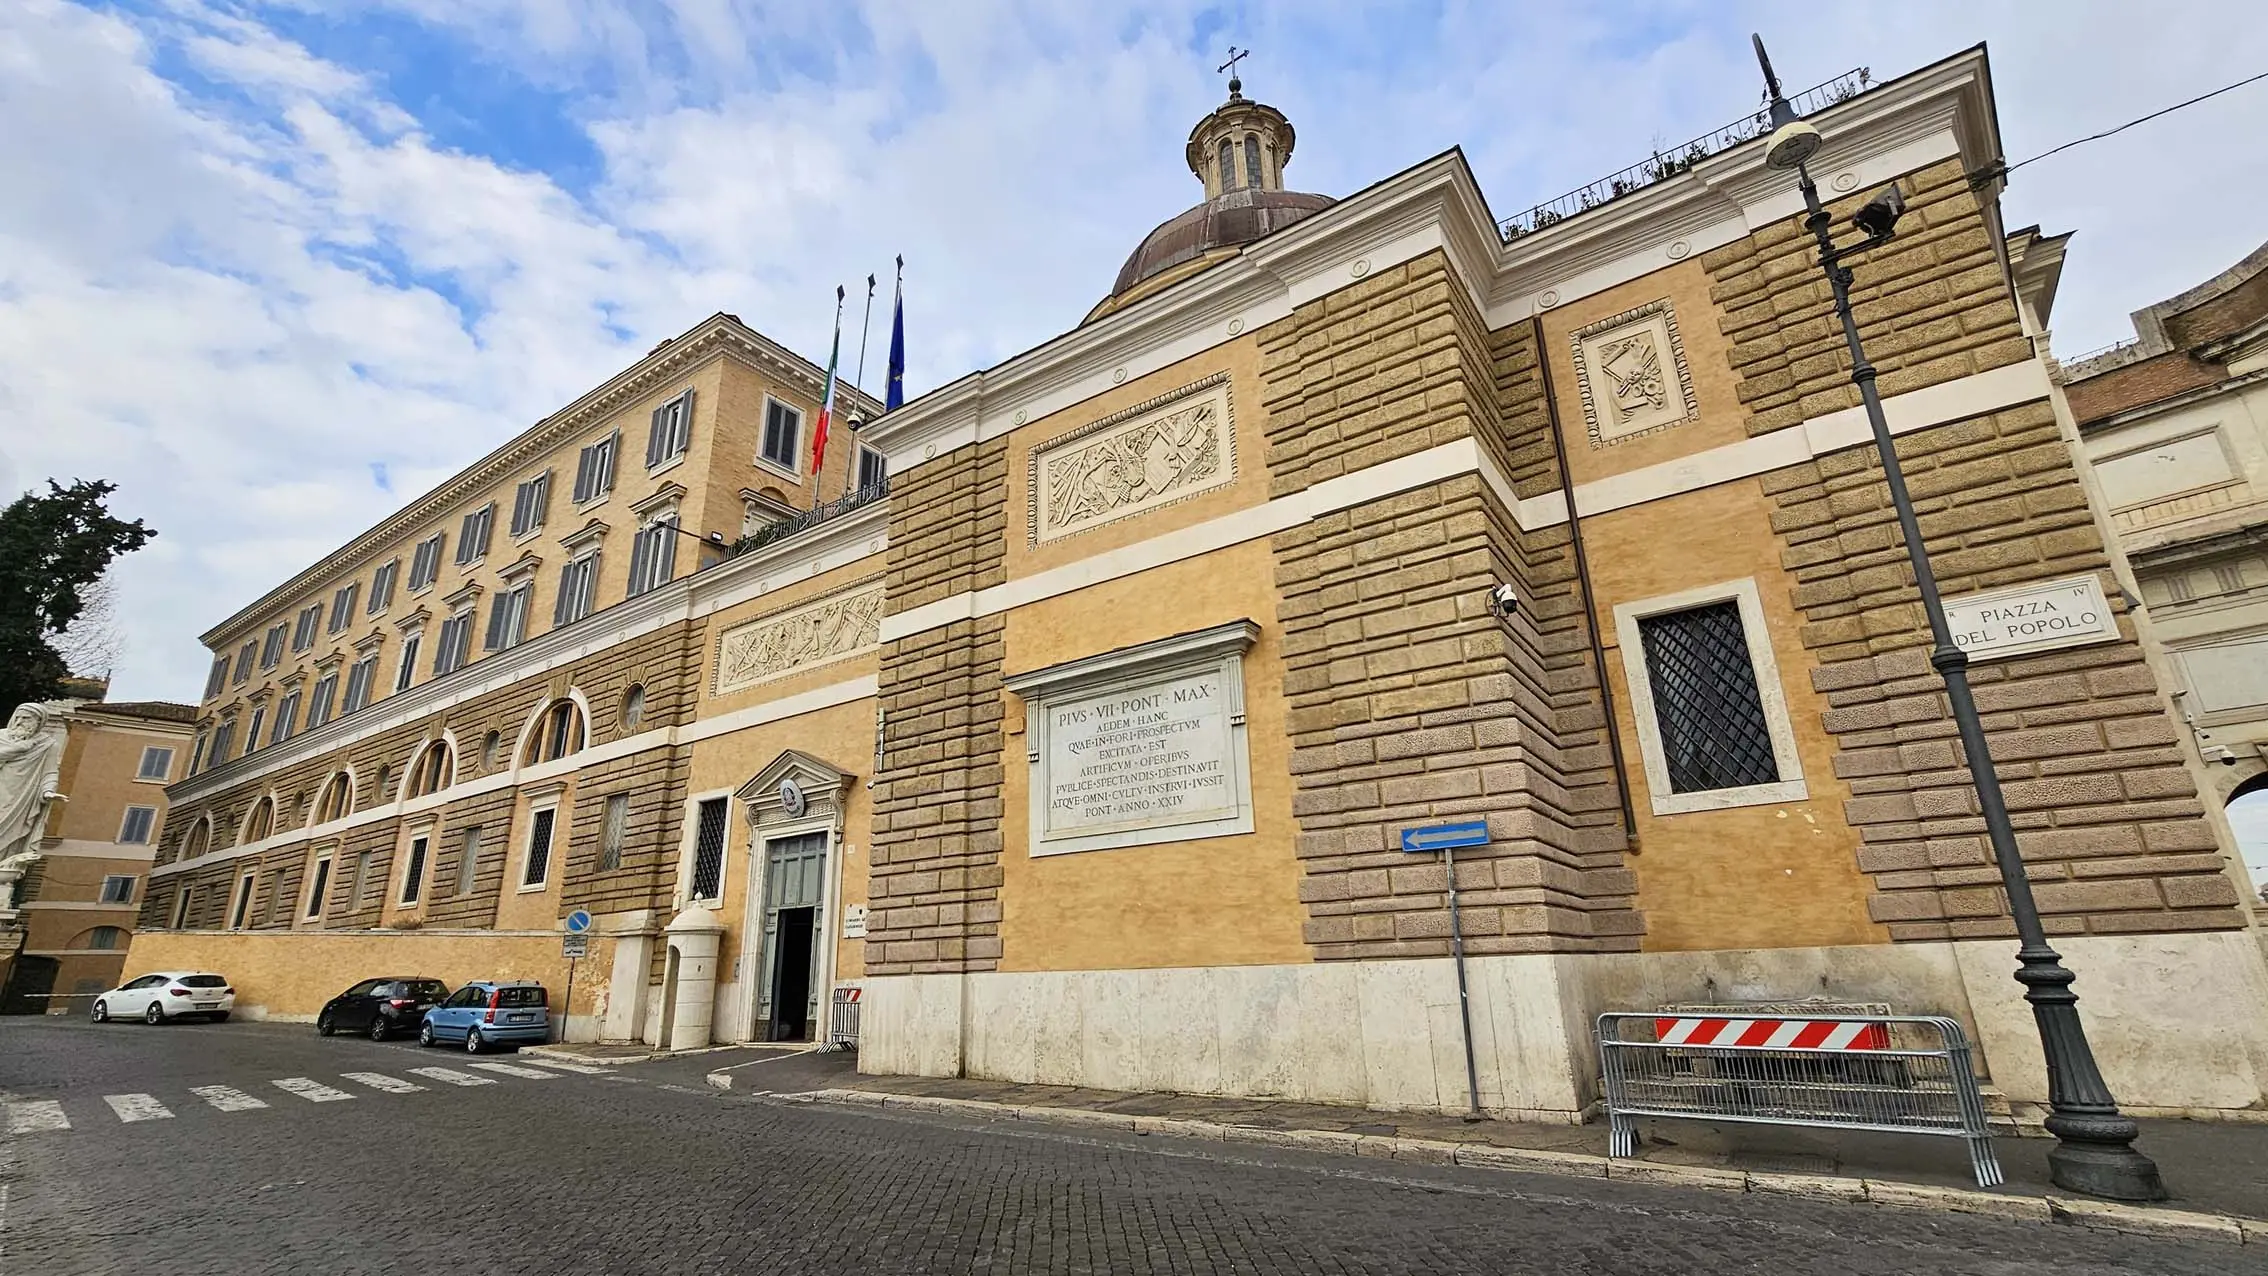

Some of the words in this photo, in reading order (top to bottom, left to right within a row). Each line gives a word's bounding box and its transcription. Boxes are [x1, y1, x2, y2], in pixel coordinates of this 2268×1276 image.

[2073, 588, 2084, 596] IV
[1981, 601, 2057, 623] PIAZZA
[1955, 631, 1996, 646] DEL
[2007, 612, 2097, 638] POPOLO
[1059, 710, 1087, 727] PIVS
[1096, 704, 1113, 718] VII
[1122, 694, 1161, 714] PONT
[1174, 684, 1209, 703] MAX
[1097, 718, 1130, 733] AEDEM
[1138, 711, 1168, 725] HANC
[1068, 739, 1091, 754] QVAE
[1095, 736, 1106, 747] IN
[1110, 731, 1133, 744] FORI
[1137, 719, 1200, 739] PROSPECTVM
[1100, 745, 1142, 760] EXCITATA
[1149, 739, 1167, 751] EST
[1056, 780, 1093, 794] PVBLICE
[1096, 770, 1154, 788] SPECTANDIS
[1158, 760, 1219, 778] DESTINAVIT
[1080, 760, 1131, 777] ARTIFICVM
[1140, 750, 1189, 766] OPERIBVS
[1052, 796, 1080, 809] ATQVE
[1083, 792, 1108, 804] OMNI
[1112, 786, 1143, 799] CVLTV
[1148, 780, 1187, 795] INSTRVI
[1085, 805, 1112, 817] PONT
[1118, 800, 1149, 813] ANNO
[1158, 795, 1184, 808] XXIV
